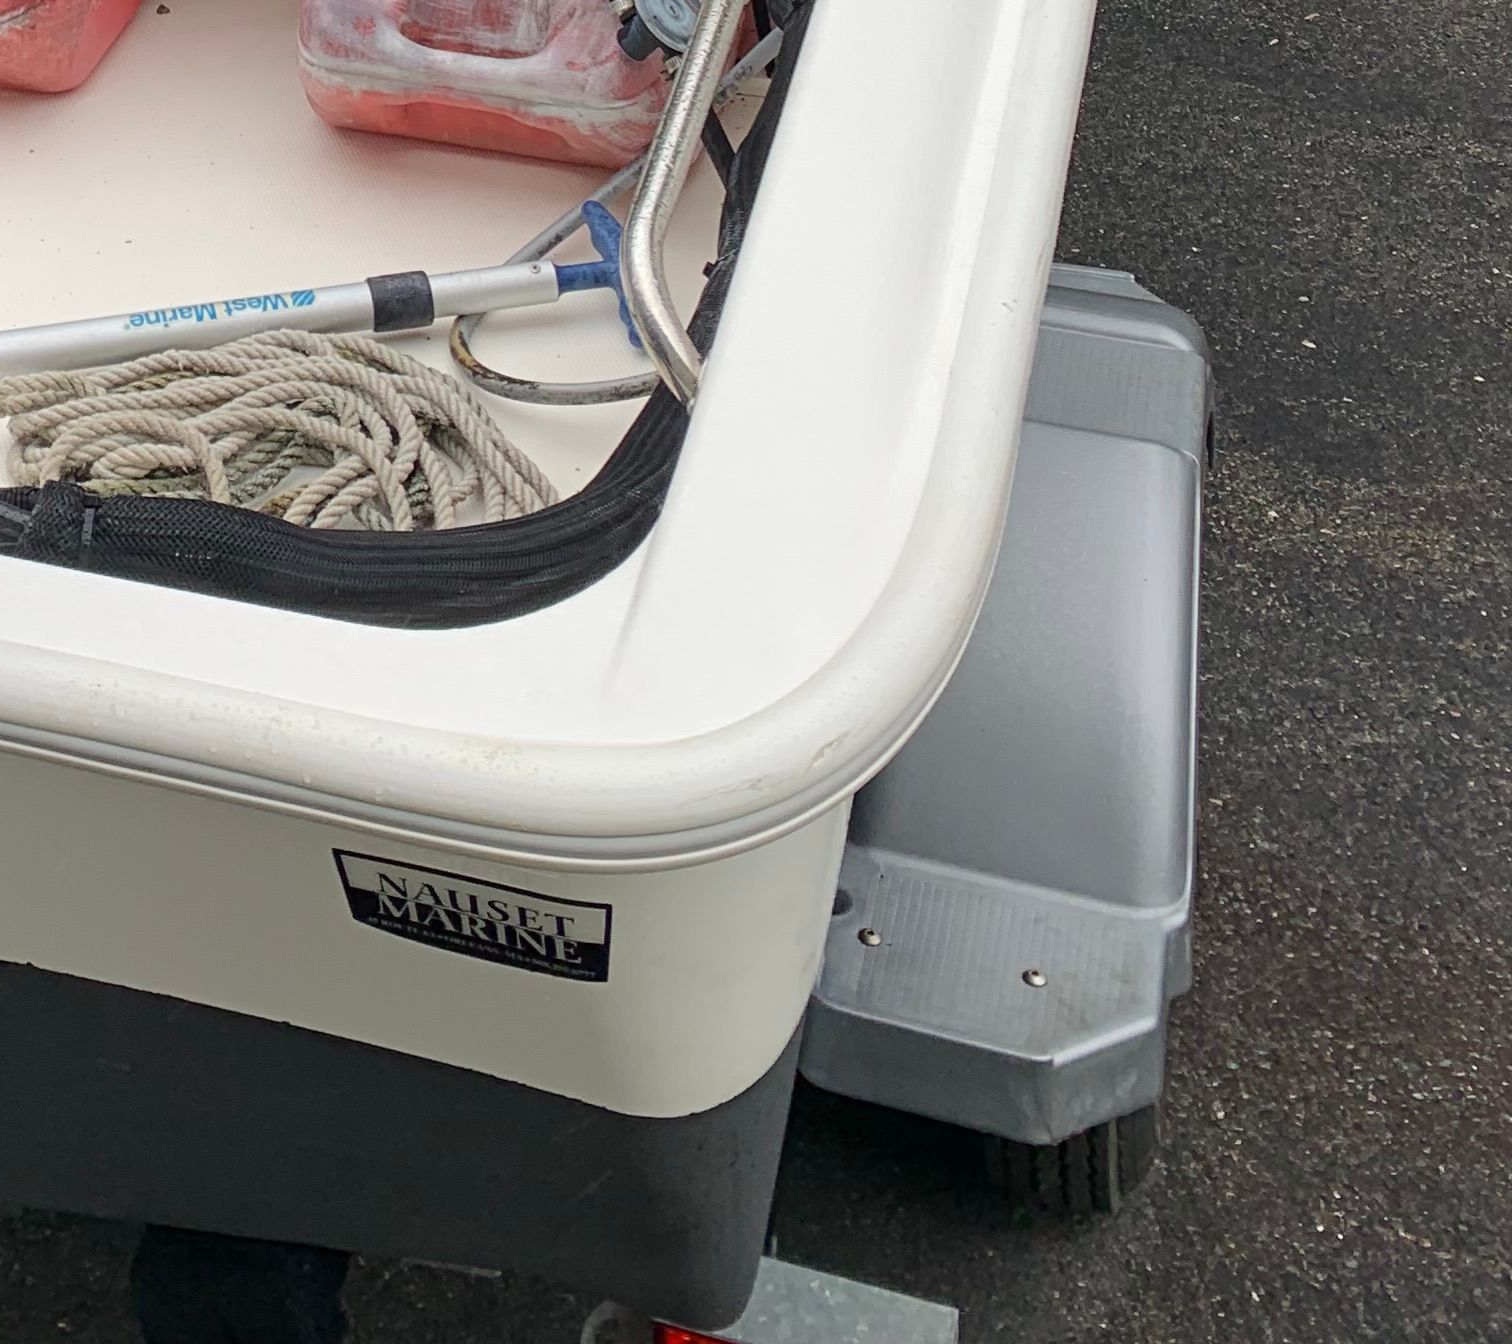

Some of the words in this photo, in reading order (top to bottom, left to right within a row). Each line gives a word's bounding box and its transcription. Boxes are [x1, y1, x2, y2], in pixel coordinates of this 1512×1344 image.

[129, 302, 218, 328] Marine
[224, 293, 289, 316] West
[377, 872, 575, 938] NAUSET
[377, 893, 582, 963] MARINE
